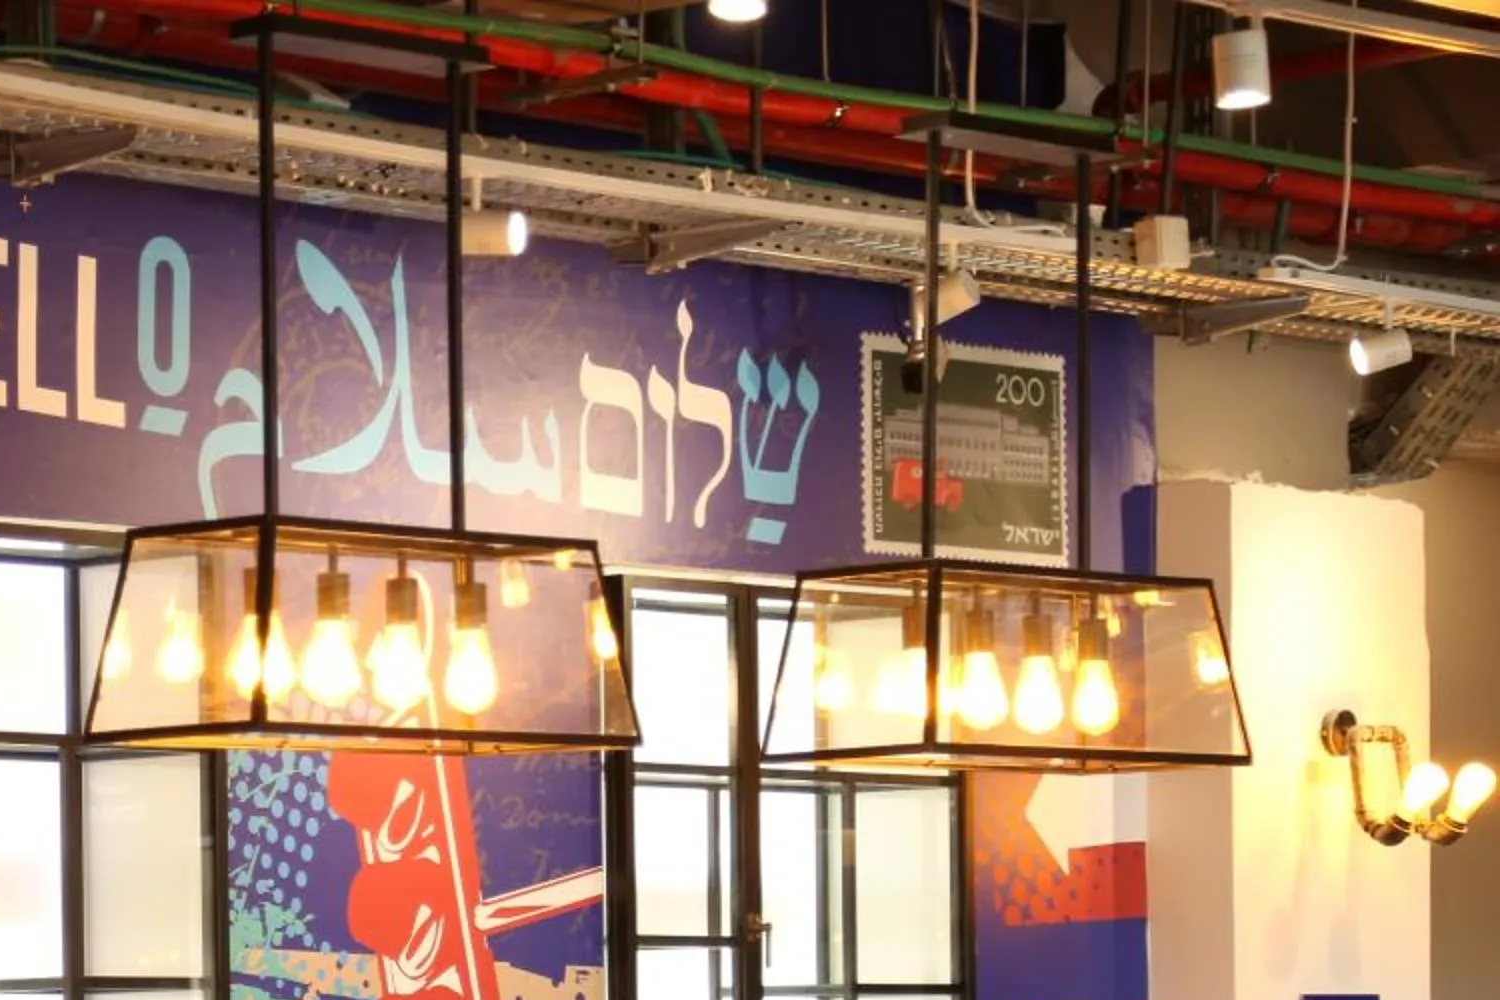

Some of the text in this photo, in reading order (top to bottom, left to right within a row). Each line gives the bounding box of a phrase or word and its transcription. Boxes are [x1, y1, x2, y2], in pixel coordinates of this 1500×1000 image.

[197, 239, 563, 521] سلام
[578, 298, 820, 532] שלום
[995, 373, 1046, 407] 200
[1002, 523, 1061, 547] ישראל
